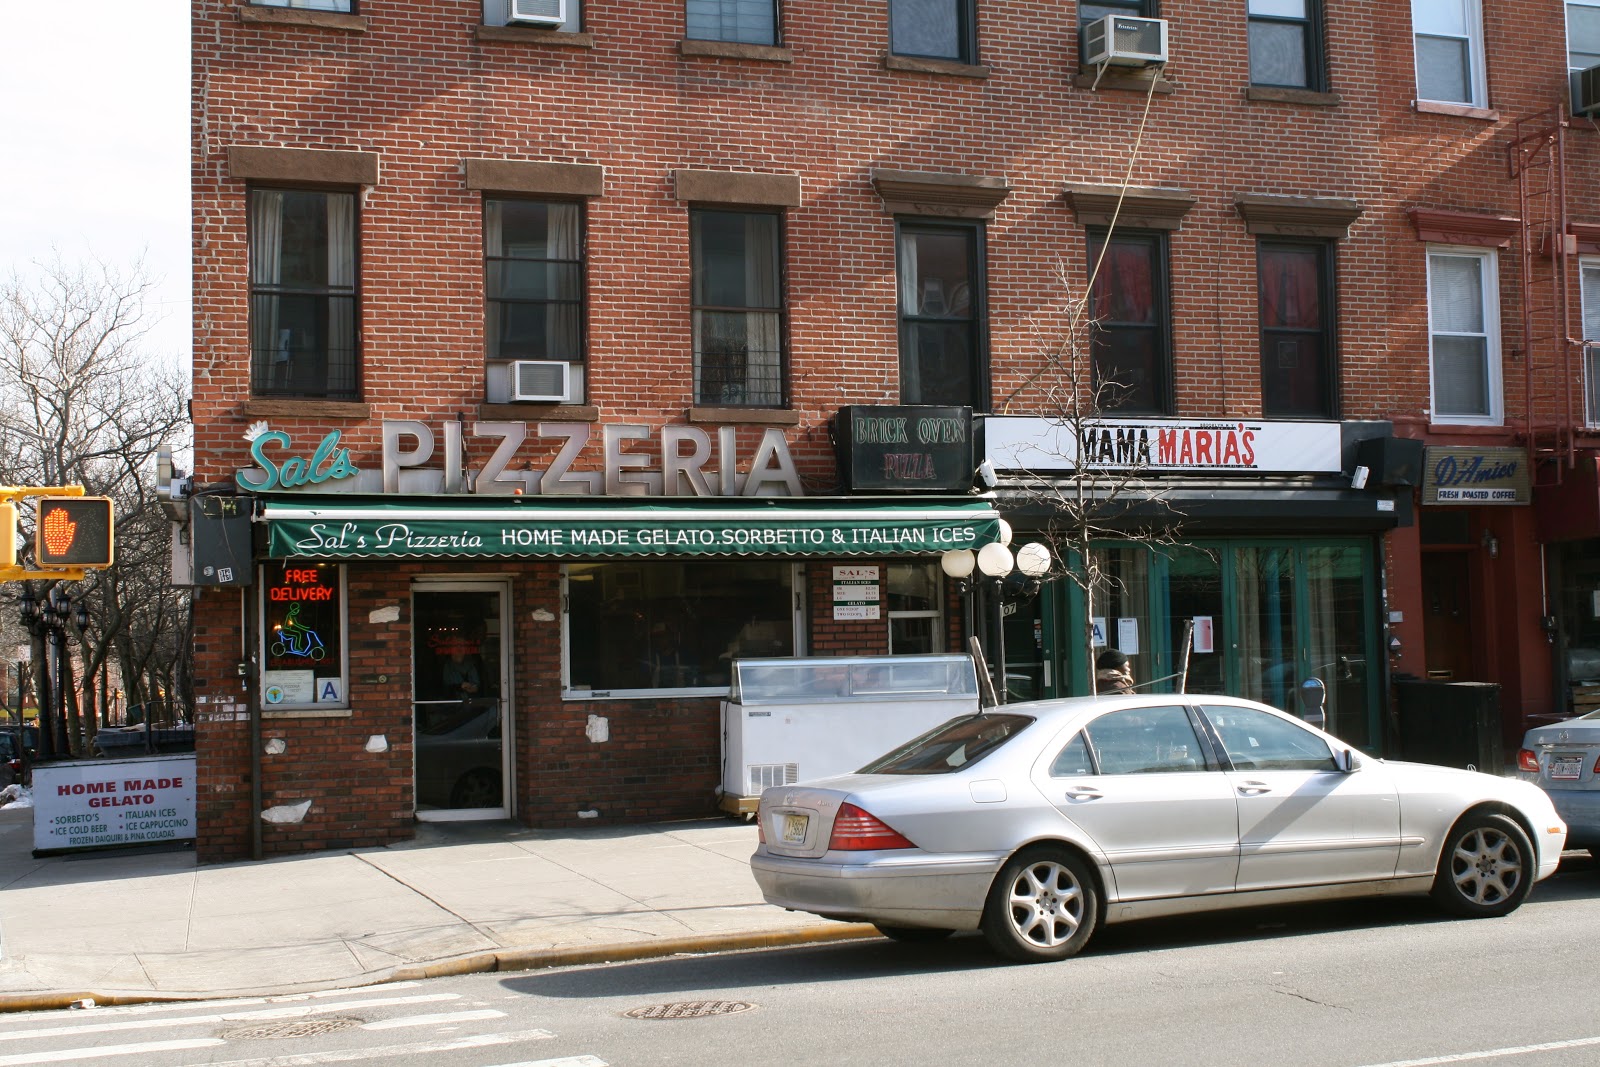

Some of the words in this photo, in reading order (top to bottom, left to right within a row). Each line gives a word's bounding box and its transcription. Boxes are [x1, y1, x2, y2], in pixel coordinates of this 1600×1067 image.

[855, 417, 908, 443] BRICK
[918, 418, 966, 444] OVEN
[1081, 428, 1151, 464] MAMA
[1158, 422, 1255, 465] MARIA'S
[235, 429, 360, 491] Sal's
[381, 420, 805, 496] PIZZERIA
[883, 453, 937, 479] PIZZA
[1432, 456, 1518, 486] D'Amico
[1438, 490, 1459, 499] FRESH
[1462, 490, 1489, 499] ROASTED
[1491, 490, 1516, 499] COFFEE
[296, 522, 367, 549] Sal's
[375, 523, 483, 549] Pizzeria
[501, 528, 563, 546] HOME
[570, 528, 629, 546] MADE
[831, 529, 844, 543] &
[852, 528, 924, 544] ITALIAN
[932, 527, 976, 542] ICES
[285, 569, 318, 583] FREE
[270, 587, 333, 601] DELIVERY
[321, 681, 338, 700] A
[57, 782, 117, 796] HOME
[124, 778, 183, 791] MADE
[88, 794, 155, 808] GELATO
[55, 813, 100, 825] SORBETO'S
[125, 809, 157, 820] ITALIAN
[159, 808, 177, 817] ICES
[55, 827, 67, 836] ICE
[69, 825, 89, 835] COLD
[91, 824, 108, 833] BEER
[126, 822, 138, 831] ICE
[140, 818, 189, 830] CAPPUCCINO
[69, 836, 94, 845] FROZEN
[95, 834, 123, 844] DAIQUIRI
[124, 834, 129, 842] &
[130, 832, 145, 840] PINA
[146, 830, 175, 839] COLADAS
